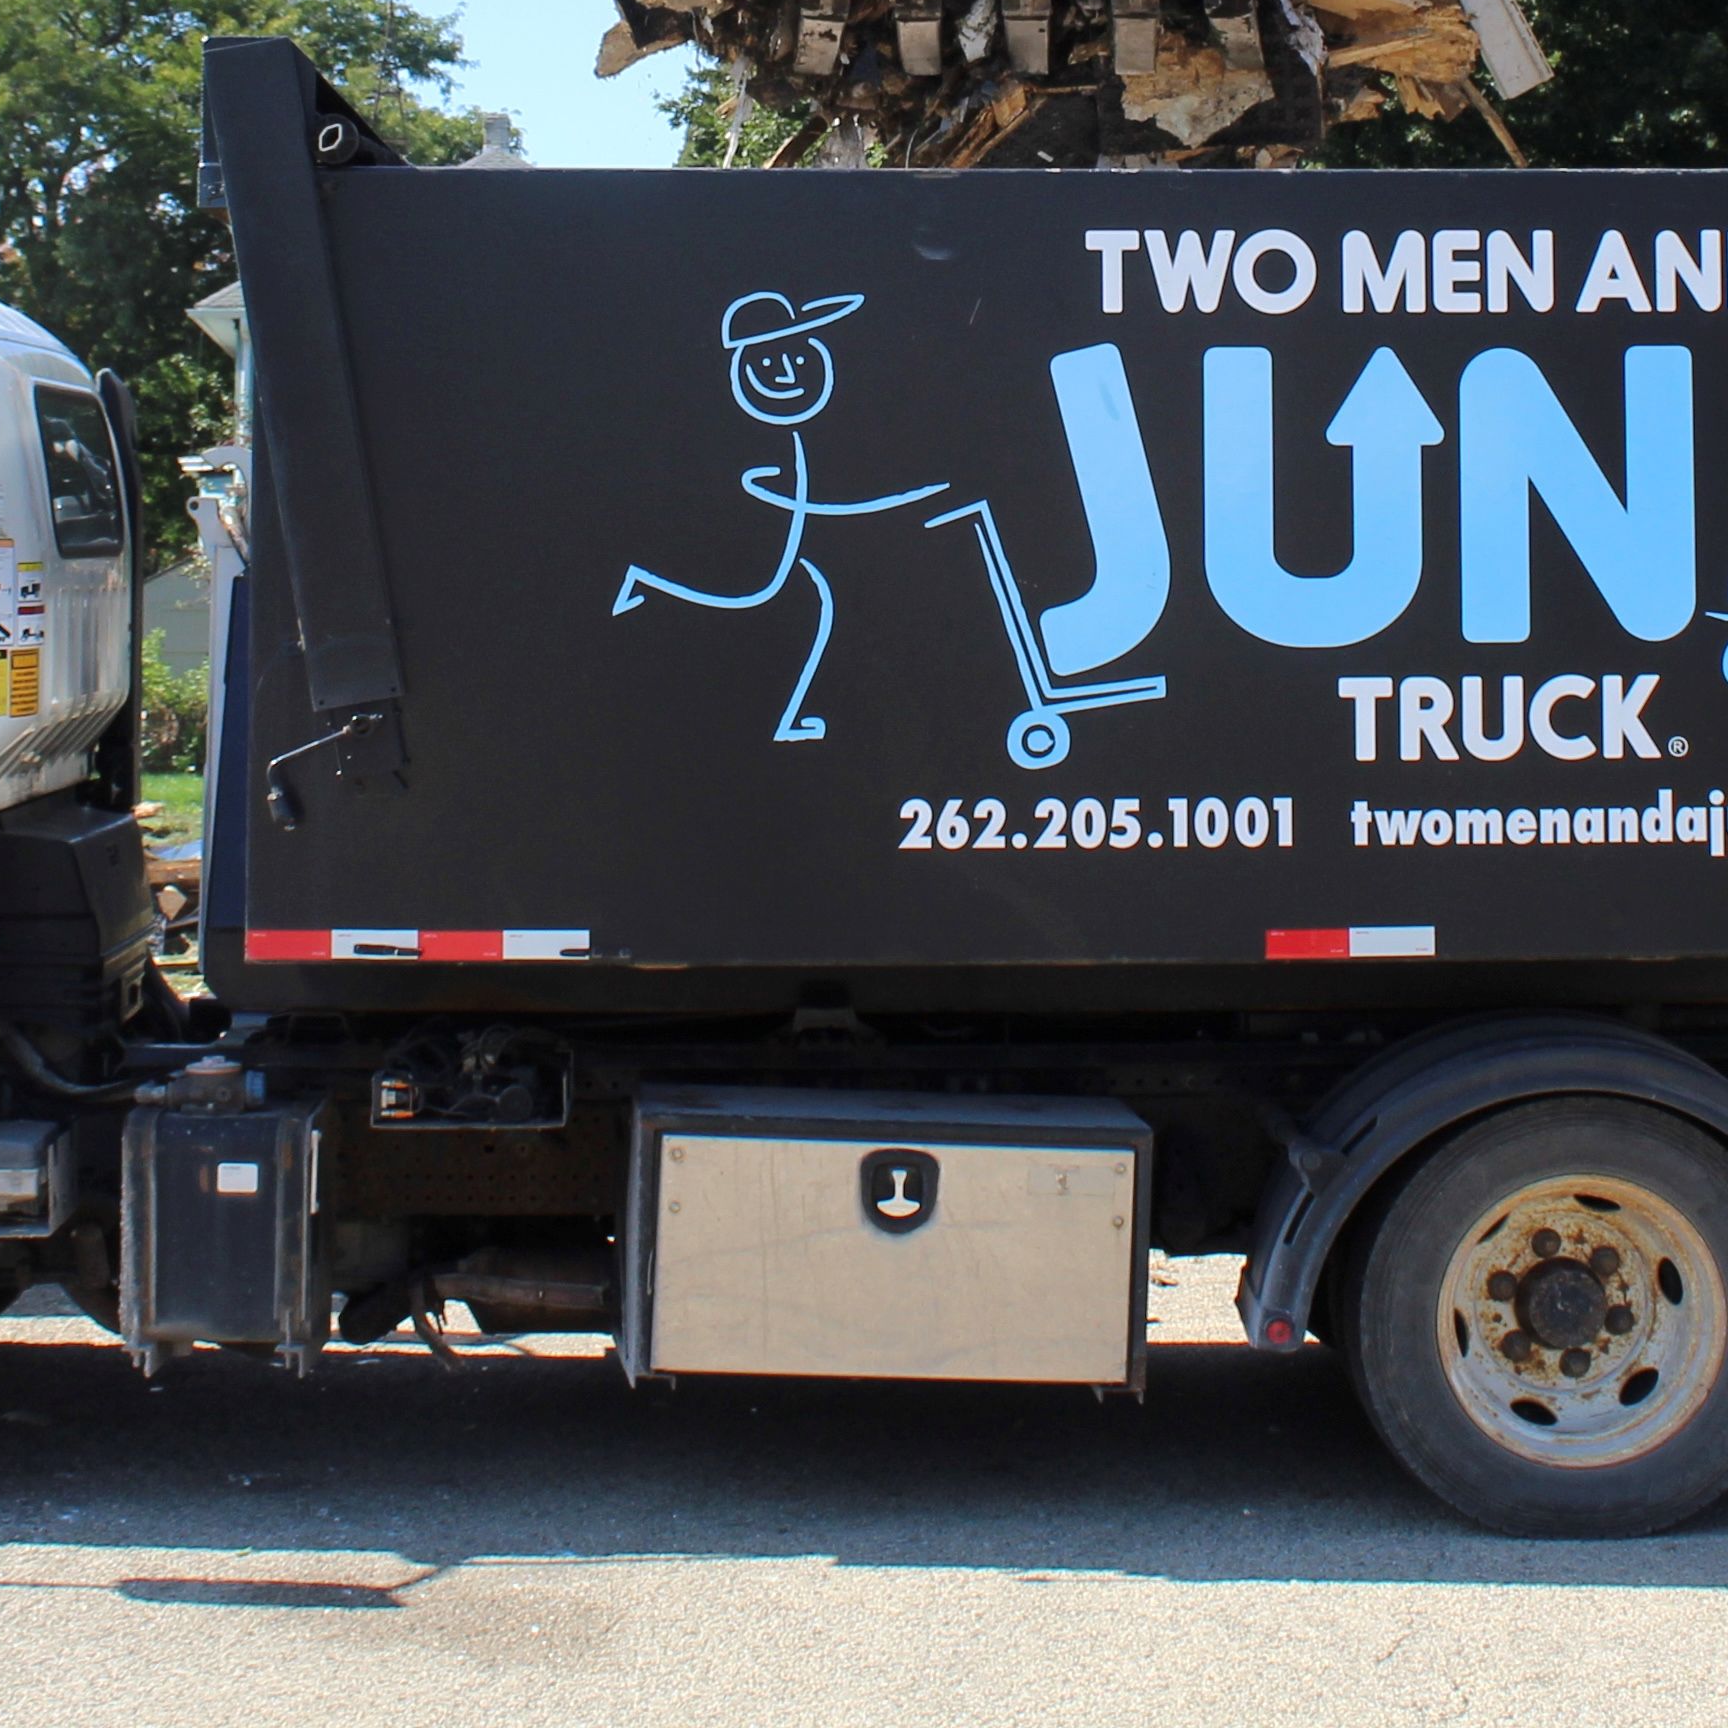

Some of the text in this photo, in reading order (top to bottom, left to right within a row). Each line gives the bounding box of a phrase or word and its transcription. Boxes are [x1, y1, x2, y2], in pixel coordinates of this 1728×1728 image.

[1085, 229, 1317, 314] TWO
[1343, 229, 1555, 314] MEN
[899, 796, 1293, 850] 262.205.1001
